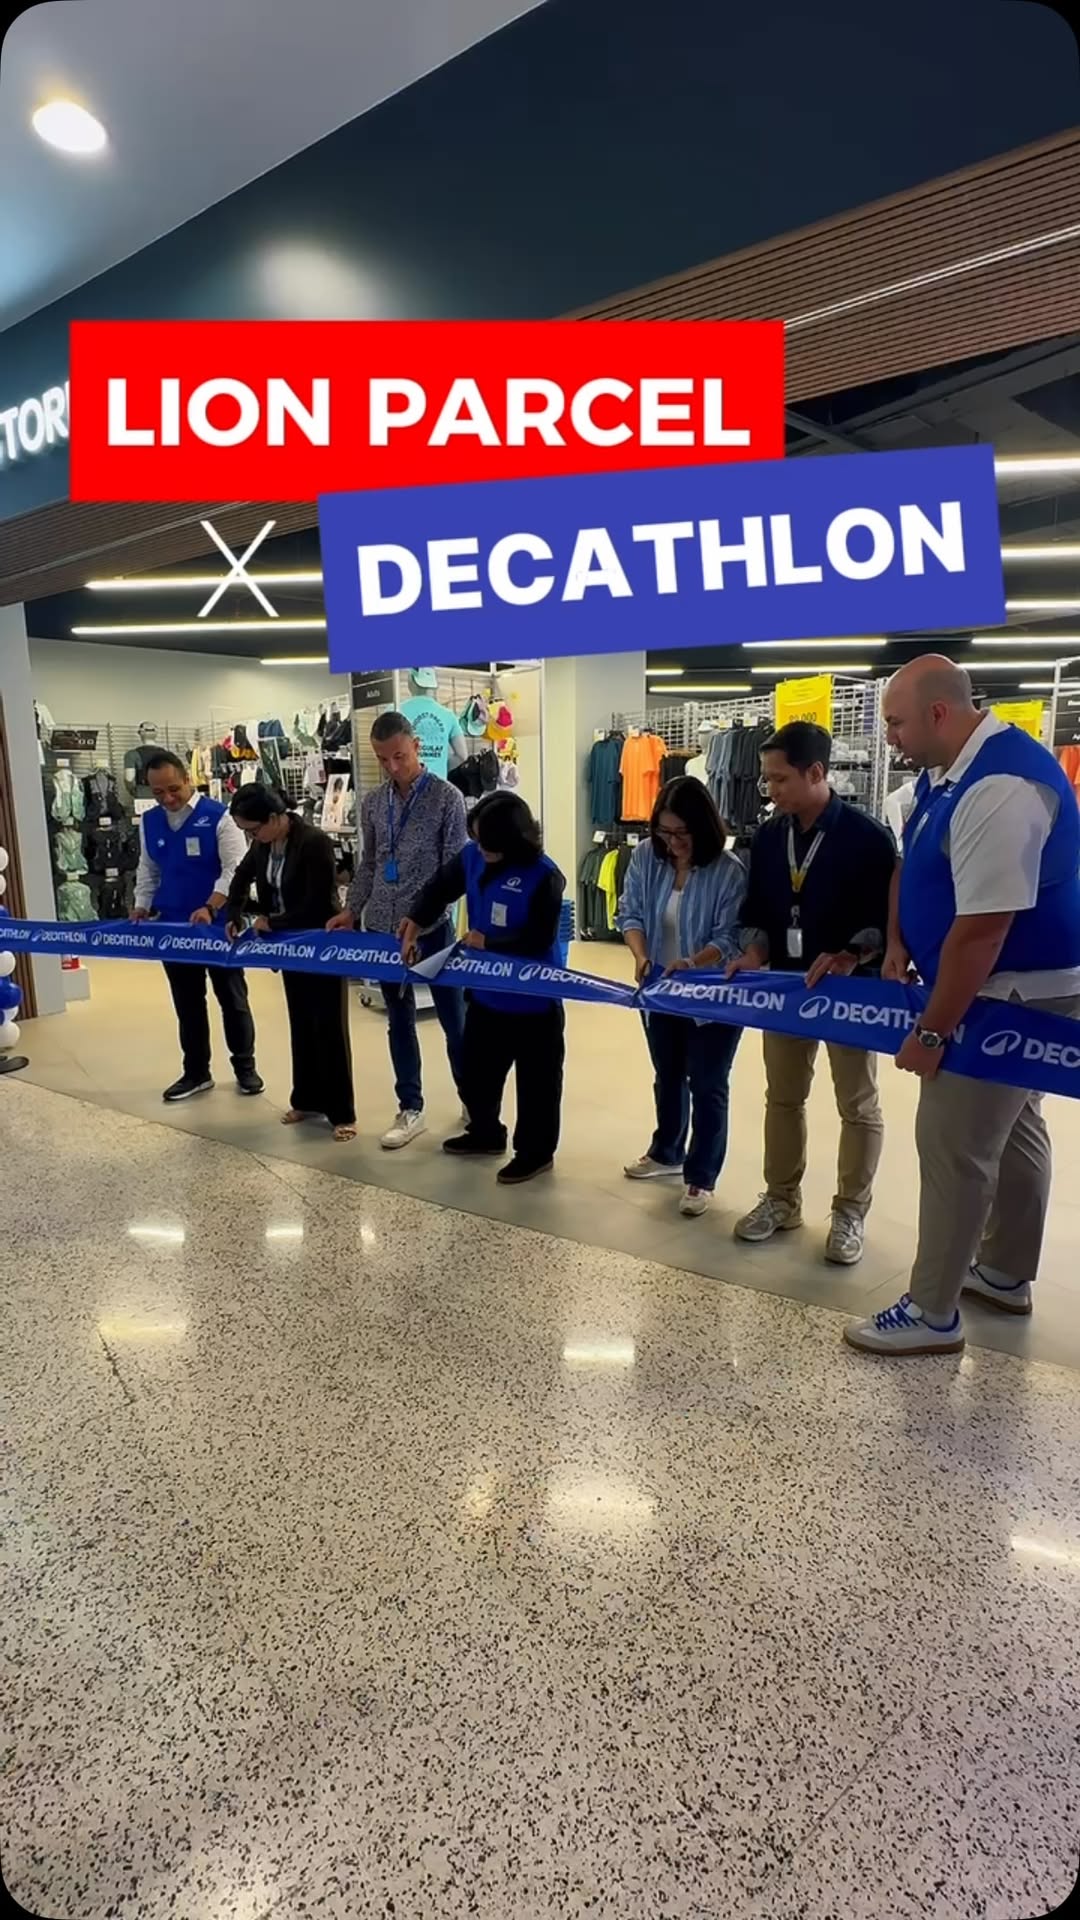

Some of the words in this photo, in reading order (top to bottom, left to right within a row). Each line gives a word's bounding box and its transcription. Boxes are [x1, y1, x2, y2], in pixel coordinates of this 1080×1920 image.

[103, 934, 154, 947] DECATHLON
[172, 938, 233, 952] DECATHLON
[251, 942, 315, 958] DECATHLON
[337, 948, 403, 965] DECATHLO
[444, 957, 513, 977] ECATHLON
[670, 982, 785, 1011] DECATHLON
[833, 1001, 965, 1044] DECATHN
